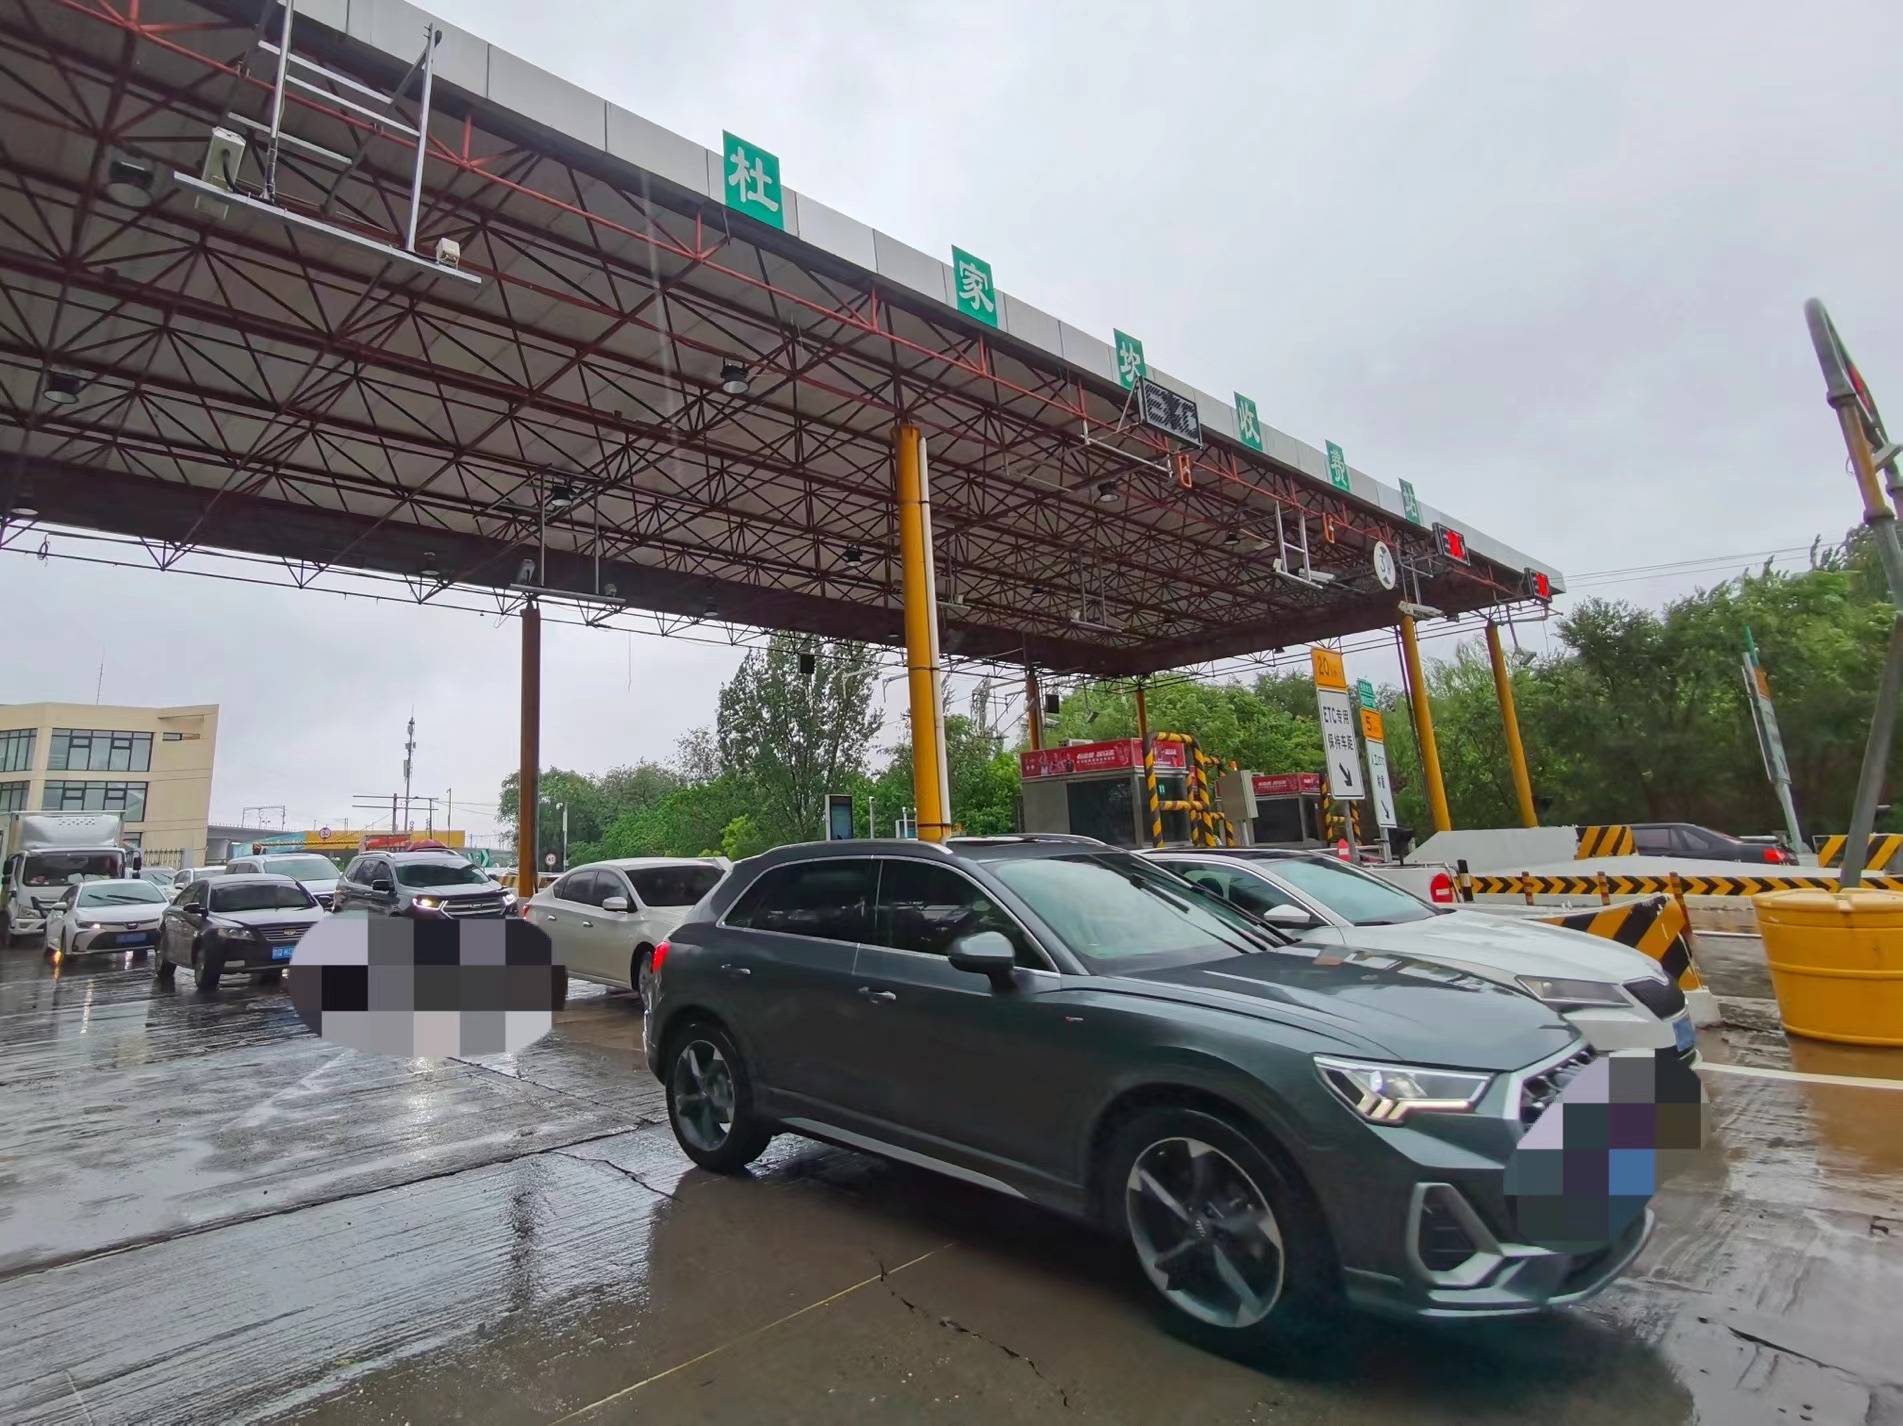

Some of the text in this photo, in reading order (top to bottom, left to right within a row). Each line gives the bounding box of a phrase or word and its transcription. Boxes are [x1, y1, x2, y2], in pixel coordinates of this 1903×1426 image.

[728, 146, 779, 212] 杜
[958, 260, 994, 313] 家
[1119, 340, 1141, 383] 坎
[1239, 400, 1261, 444] 收
[1331, 448, 1348, 487] 费
[1323, 706, 1350, 724] ETC专用
[1328, 732, 1354, 751] 保持车距
